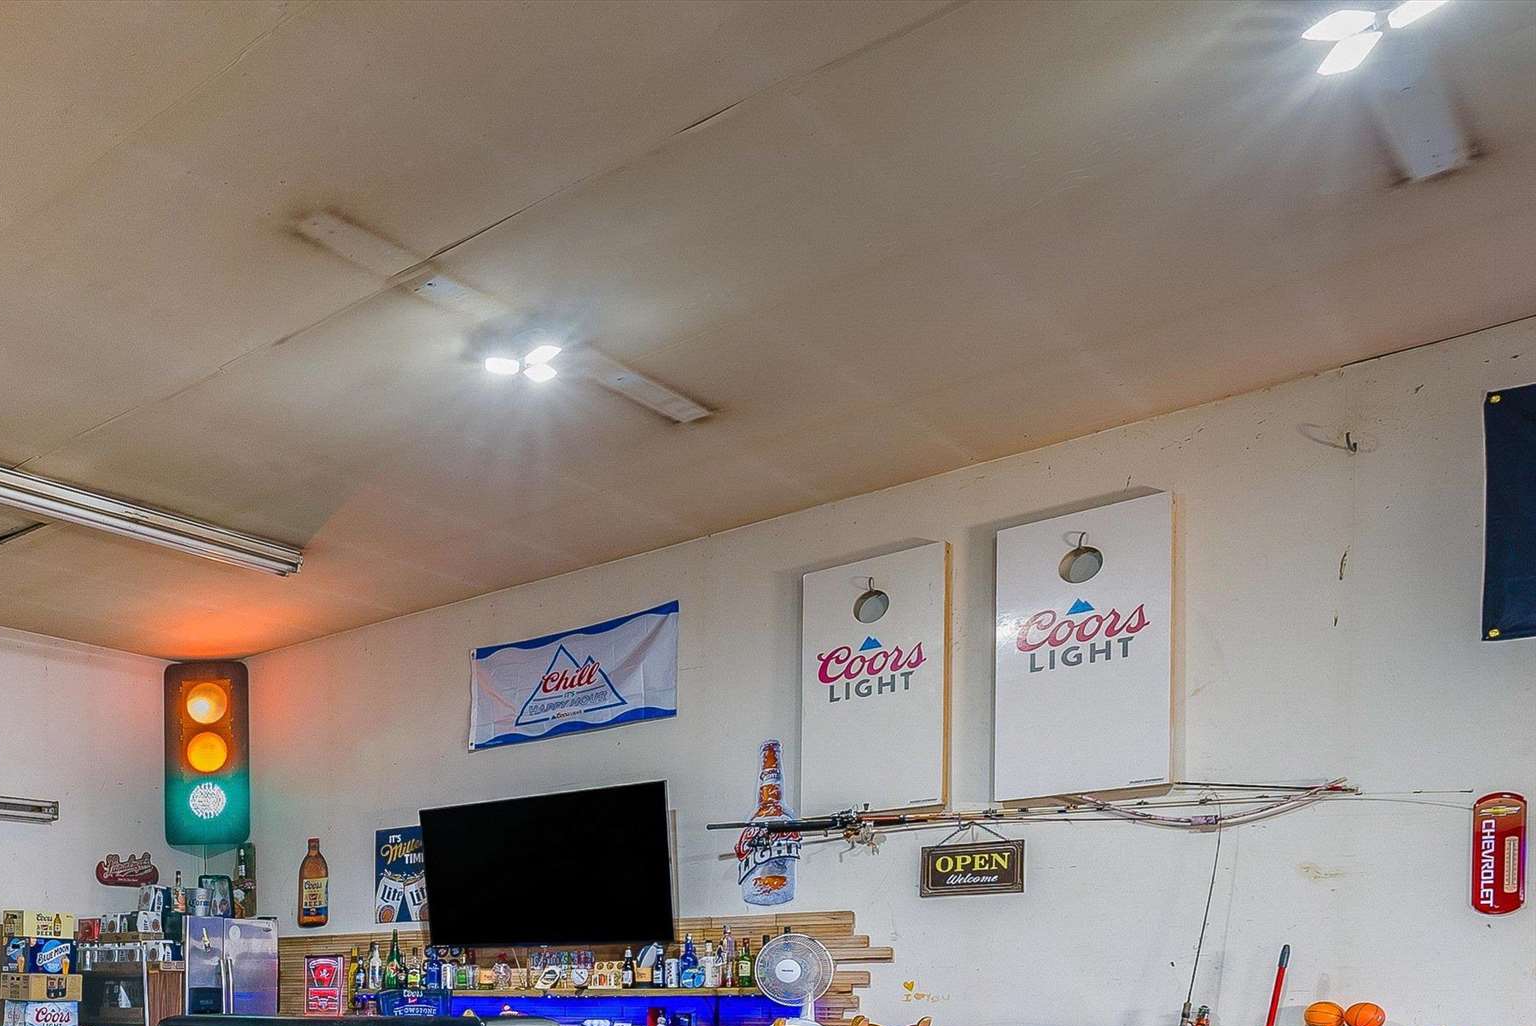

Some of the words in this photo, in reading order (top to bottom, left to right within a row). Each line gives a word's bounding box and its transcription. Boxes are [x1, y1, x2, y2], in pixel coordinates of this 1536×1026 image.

[1016, 604, 1151, 651] Coors
[817, 641, 927, 684] Coors
[1029, 636, 1134, 673] LIGHT
[541, 662, 601, 694] Chill
[829, 671, 914, 703] LIGHT
[528, 700, 569, 716] HAPPY
[389, 835, 401, 843] IT'S
[935, 852, 1010, 873] OPEN
[1480, 819, 1495, 907] CHEVROLET
[304, 880, 322, 889] Coors
[946, 873, 998, 885] Welcome
[380, 884, 403, 903] Lite
[409, 886, 426, 906] Lit
[37, 949, 55, 964] BLUE
[54, 944, 70, 958] MOON
[35, 1007, 71, 1023] Coors
